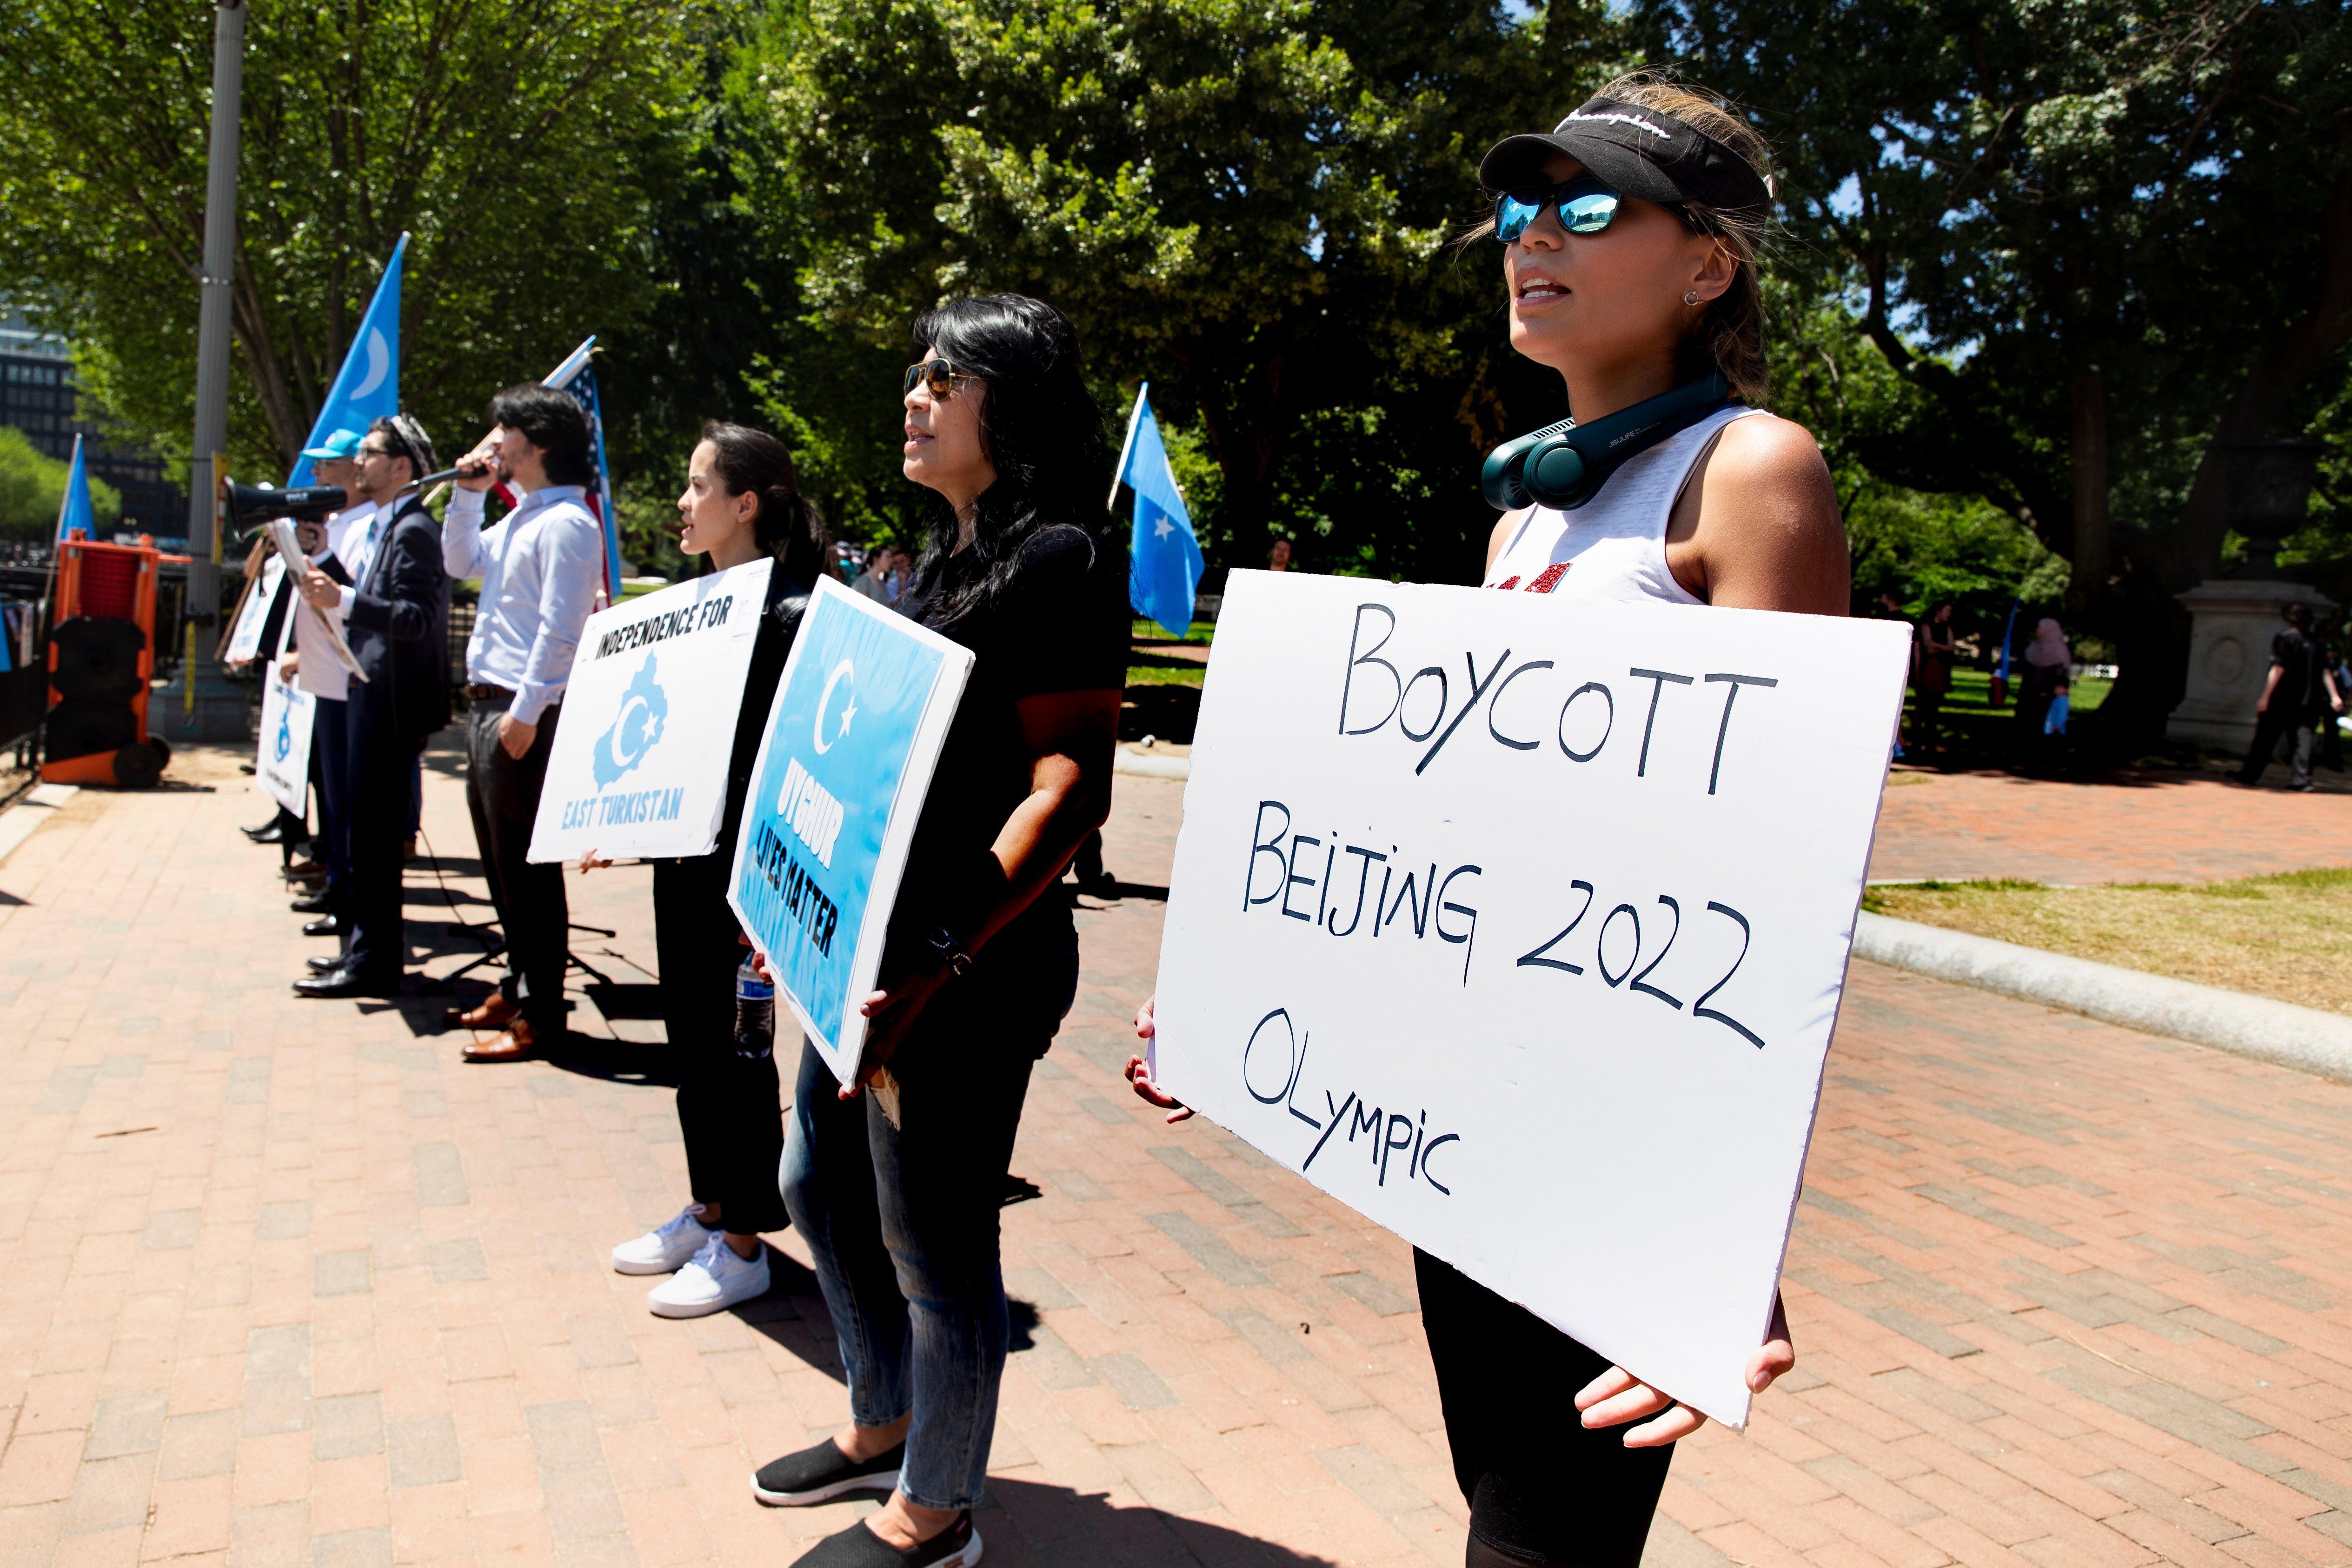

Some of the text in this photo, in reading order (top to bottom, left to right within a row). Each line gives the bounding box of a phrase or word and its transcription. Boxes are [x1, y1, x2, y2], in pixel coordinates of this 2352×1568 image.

[1609, 431, 1635, 448] JISULIFE
[595, 595, 733, 660] INDEPENDENCE FOR
[562, 787, 684, 830] EAST TURKISTAN
[777, 757, 844, 870] UYGHUR
[756, 820, 838, 960] LIVES MATTER
[1516, 880, 1765, 1050] 2022
